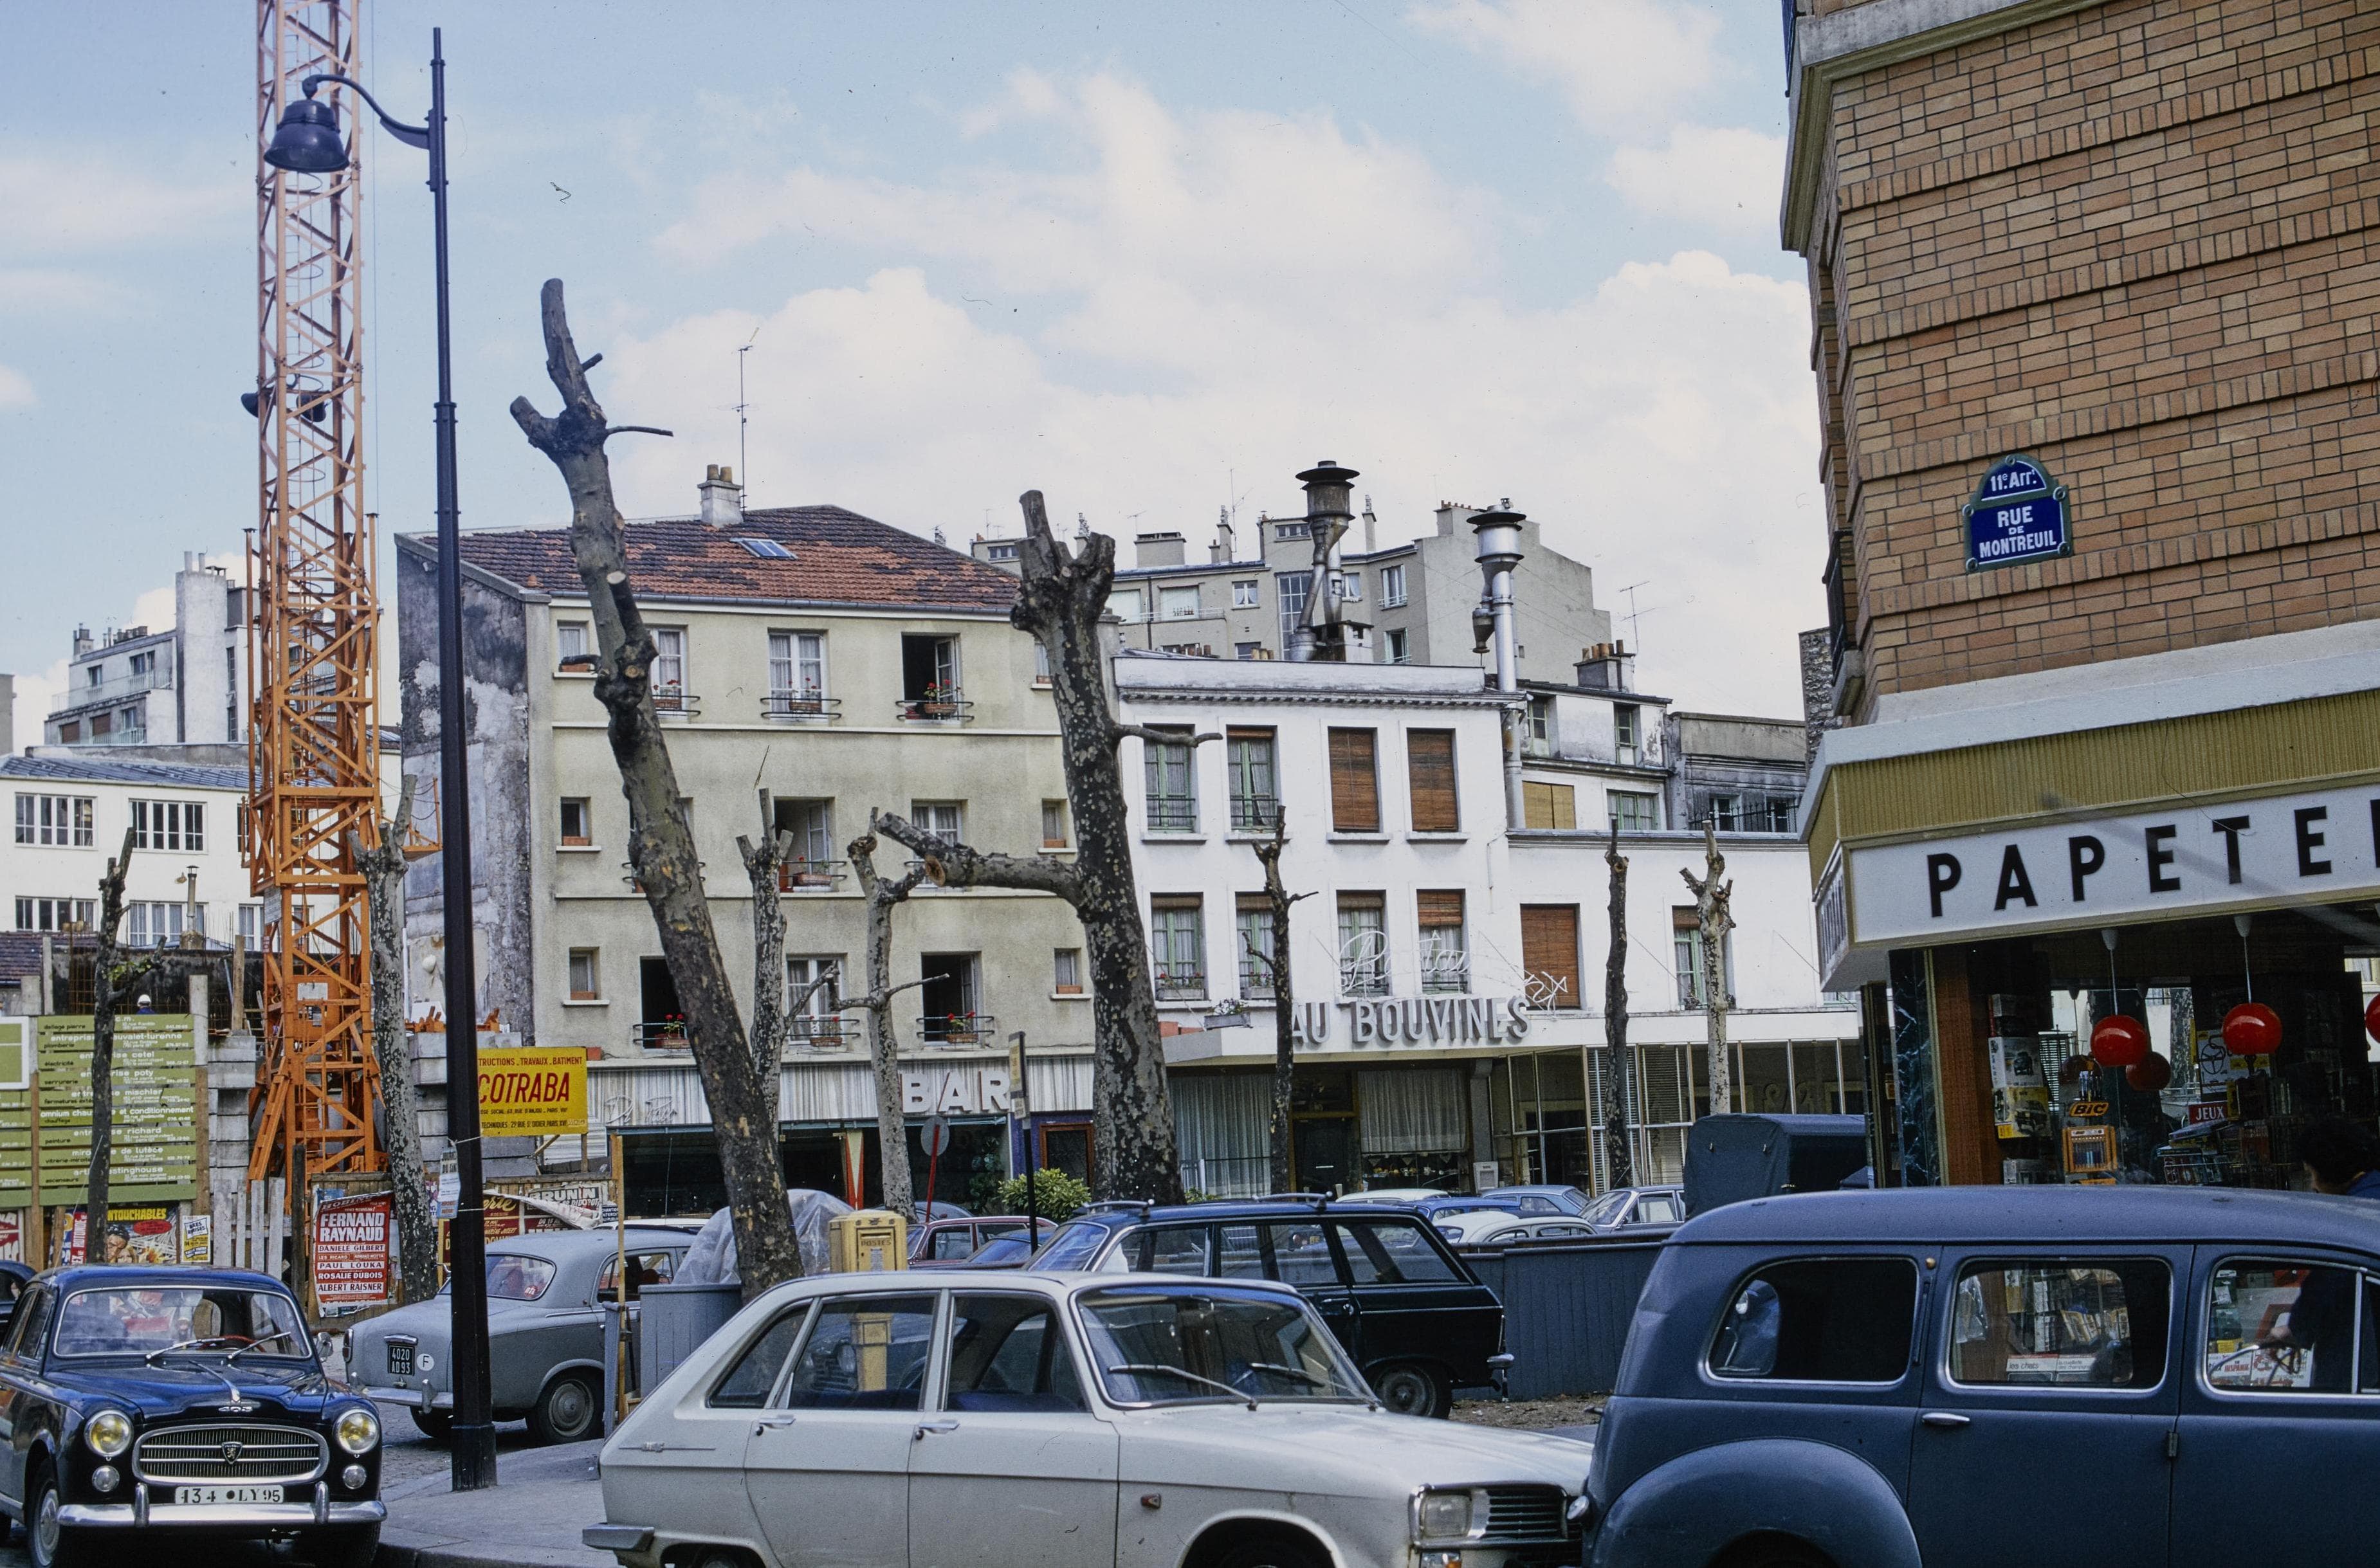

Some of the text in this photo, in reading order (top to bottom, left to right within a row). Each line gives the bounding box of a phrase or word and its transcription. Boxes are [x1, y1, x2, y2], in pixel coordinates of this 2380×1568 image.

[1997, 506, 2033, 527] RUE
[2008, 525, 2024, 535] DE
[1979, 529, 2056, 558] MONTREUIL
[1292, 996, 1530, 1045] AU BOUVINES
[479, 1057, 582, 1066] TRUCTIONS TRAVAUX BATIMENT
[899, 1068, 1011, 1113] BAR
[129, 1106, 194, 1115] conditionnement
[2196, 1106, 2225, 1121] JEUX
[107, 1208, 167, 1221] NTOUCHABLES
[320, 1213, 385, 1227] FERNAND
[320, 1227, 384, 1242] RAYNAUD
[392, 1348, 410, 1360] 4020
[423, 1355, 430, 1367] F
